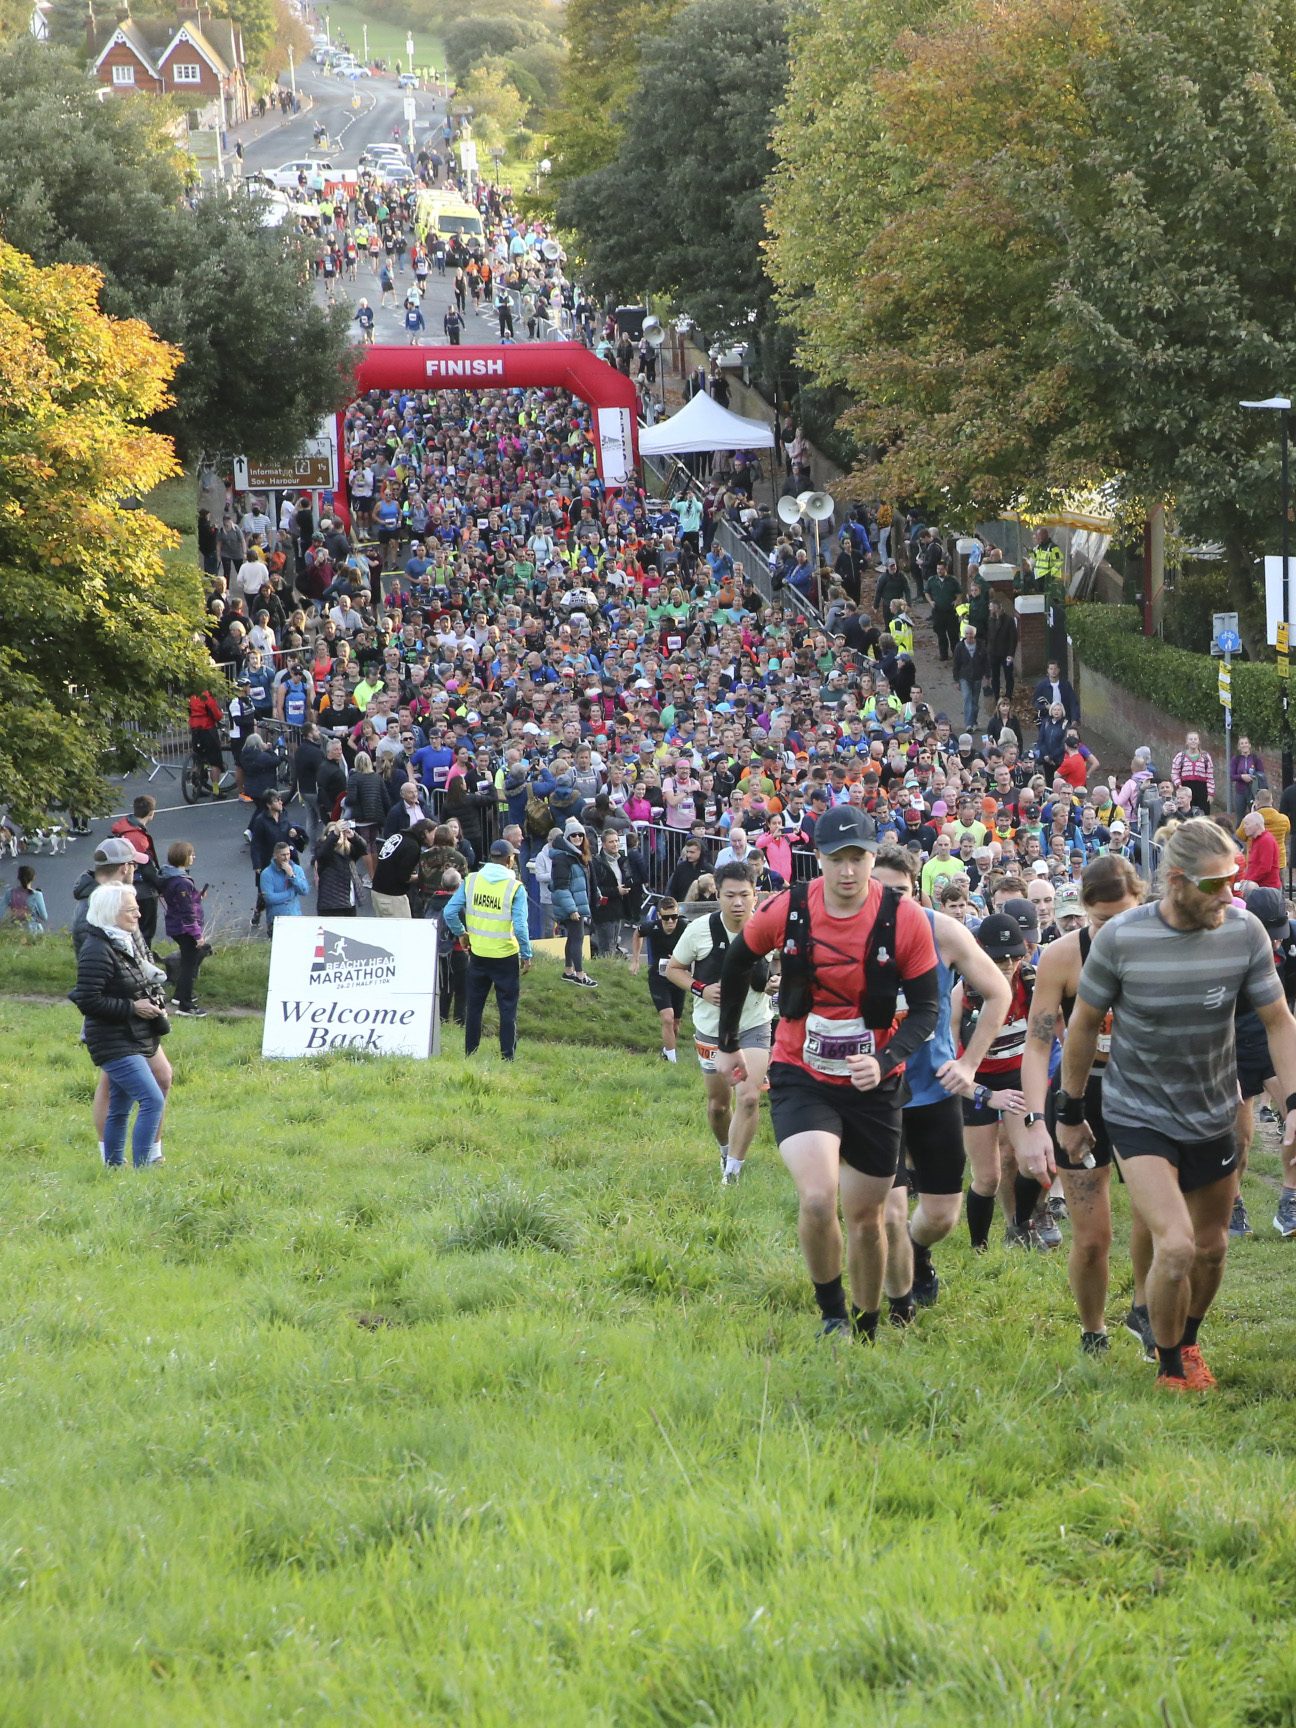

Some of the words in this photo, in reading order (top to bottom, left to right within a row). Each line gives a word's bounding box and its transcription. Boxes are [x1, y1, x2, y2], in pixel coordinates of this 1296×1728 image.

[426, 359, 503, 376] FINISH
[269, 477, 300, 485] Harbour
[473, 893, 501, 910] MARSHAL
[326, 958, 367, 970] BEACHY
[369, 956, 395, 966] HEAD
[309, 965, 396, 986] MARATHON
[281, 1000, 415, 1026] Welcome
[305, 1027, 384, 1050] Back
